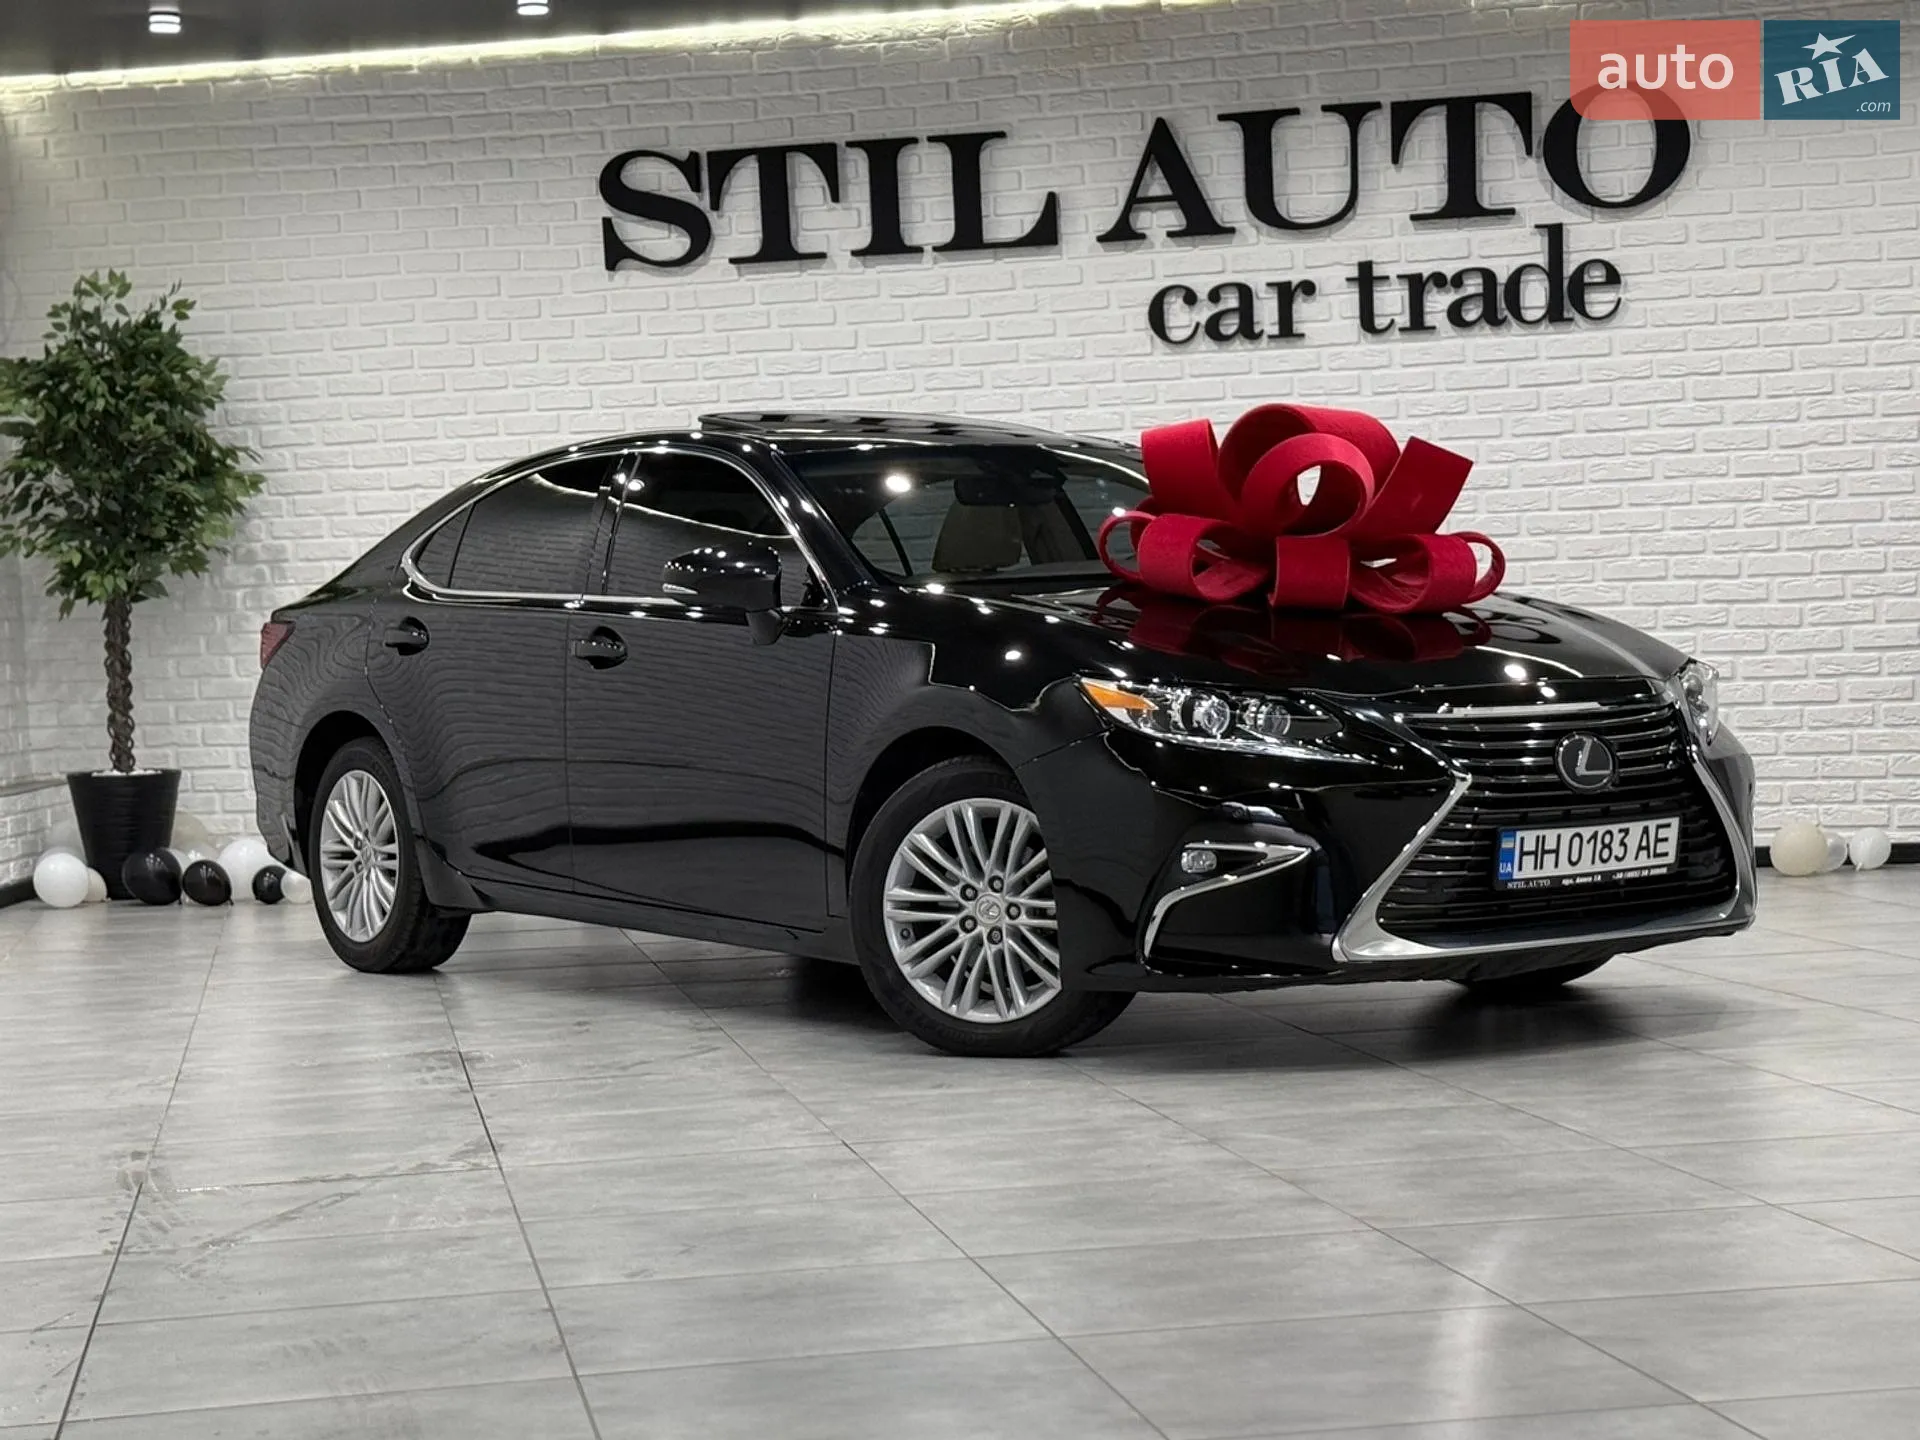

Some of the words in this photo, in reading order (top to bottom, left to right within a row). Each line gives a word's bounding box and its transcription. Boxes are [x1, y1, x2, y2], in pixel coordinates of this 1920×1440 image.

[599, 131, 1058, 271] STIL
[1096, 82, 1691, 241] AUTO
[1147, 278, 1316, 345] car
[1345, 222, 1622, 335] trade
[1500, 862, 1512, 873] UA
[1518, 833, 1561, 872] HH
[1567, 828, 1630, 867] 0183
[1635, 823, 1672, 861] AE
